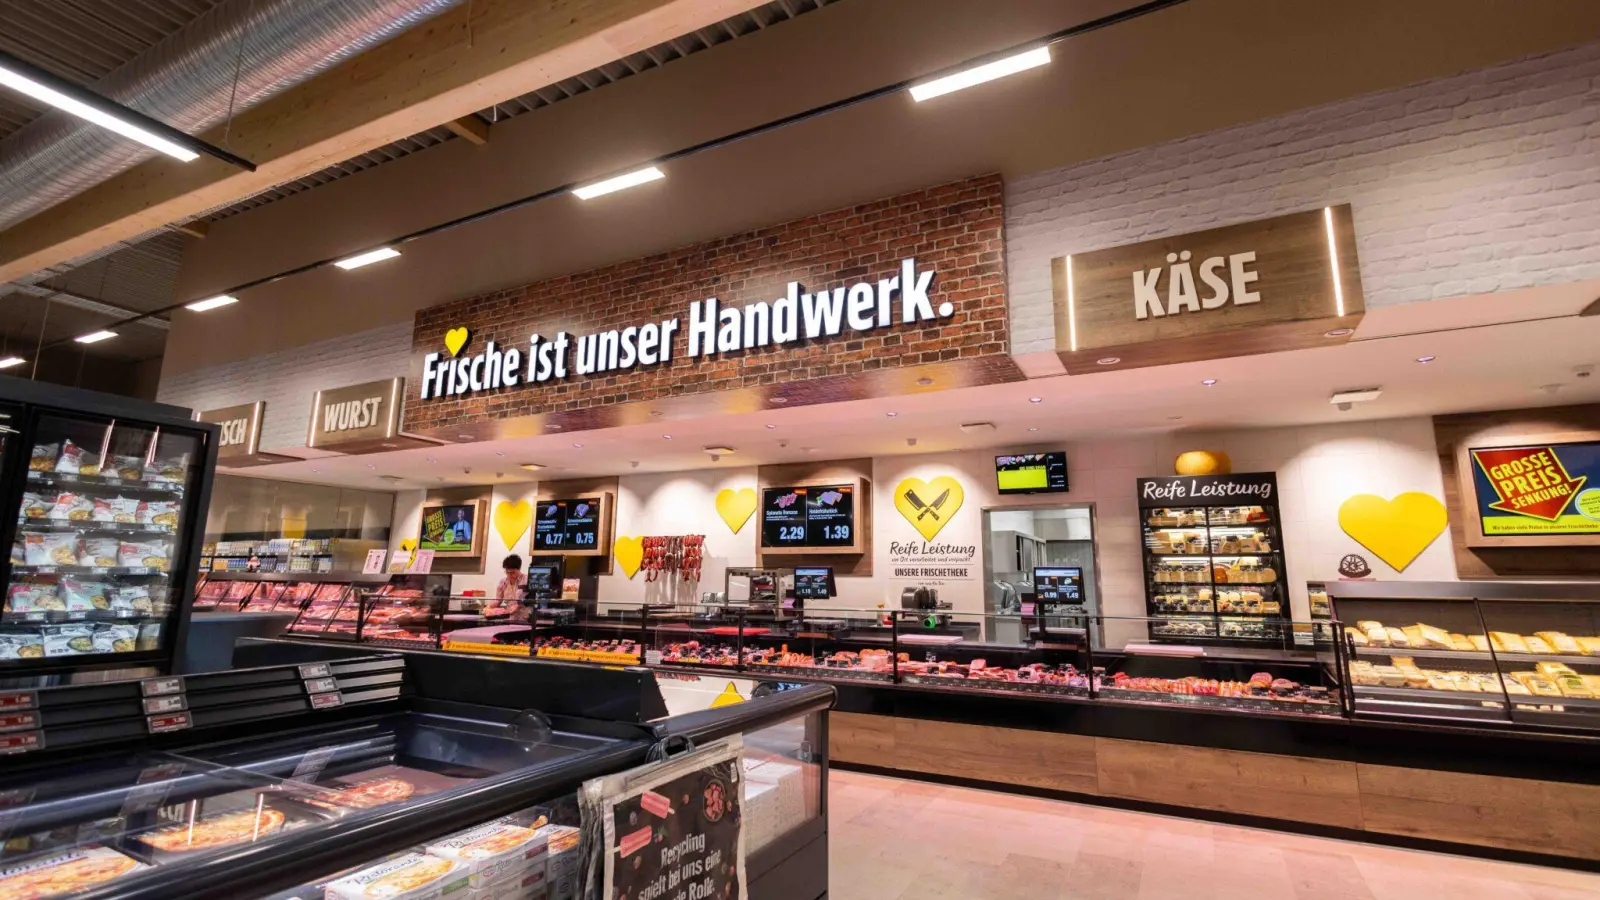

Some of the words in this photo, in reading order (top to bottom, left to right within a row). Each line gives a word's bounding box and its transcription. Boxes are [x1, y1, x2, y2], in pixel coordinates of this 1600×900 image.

[1132, 250, 1260, 319] KÄSE
[421, 341, 520, 399] Frische
[527, 332, 568, 382] ist
[576, 318, 678, 375] unser
[688, 258, 954, 357] Handwerk.
[323, 396, 382, 432] WURST
[1490, 451, 1552, 480] GROSSE
[1143, 480, 1186, 500] Reife
[1190, 479, 1272, 499] Leistung
[1499, 465, 1562, 498] PREIS
[1511, 483, 1573, 509] SENKUNG!
[546, 533, 563, 545] 0.77
[576, 532, 593, 544] 0.75
[780, 526, 804, 540] 2.29
[824, 525, 849, 539] 1.39
[890, 541, 919, 557] Reife
[921, 541, 976, 558] Leistung
[895, 568, 919, 577] UNSERE
[921, 568, 968, 577] FRISCHETHEKE
[661, 833, 705, 867] Recycling
[638, 875, 667, 900] spielt
[668, 864, 680, 890] bei
[682, 859, 703, 880] uns
[705, 849, 721, 872] eine
[689, 876, 715, 900] Rolle.
